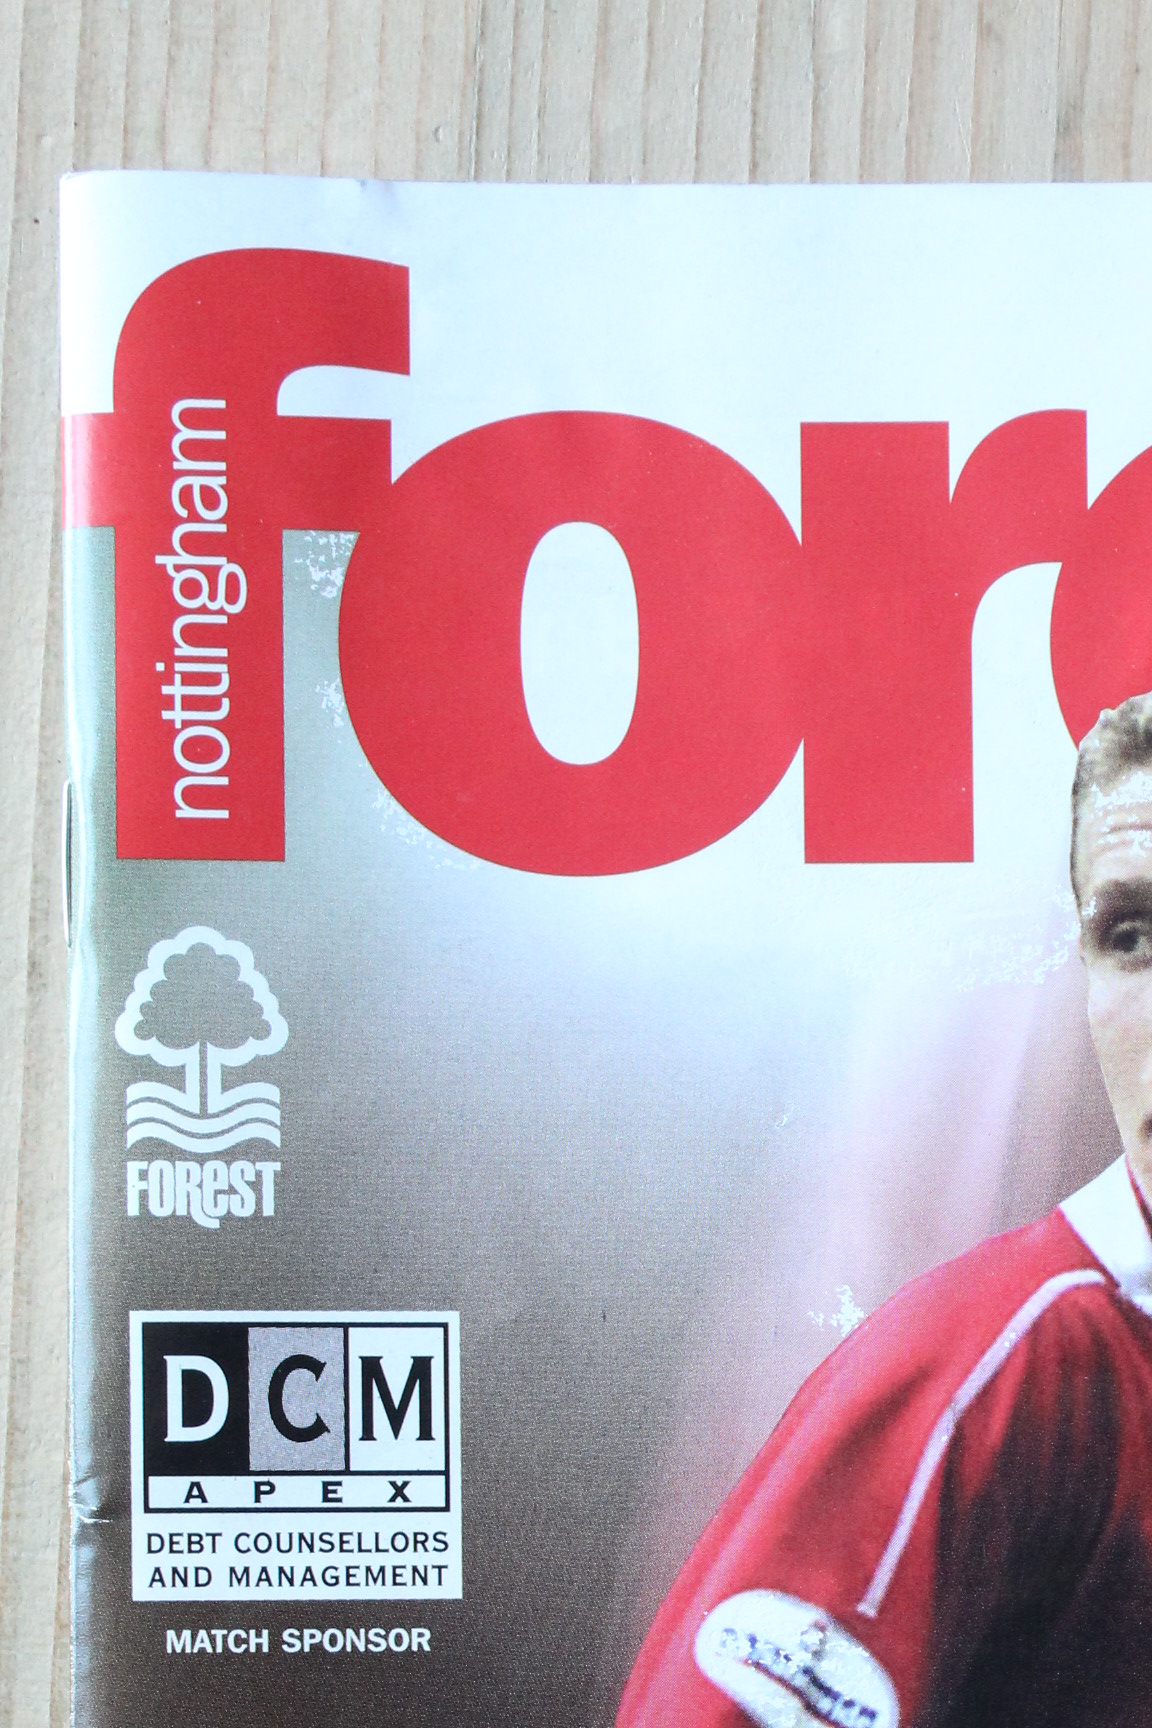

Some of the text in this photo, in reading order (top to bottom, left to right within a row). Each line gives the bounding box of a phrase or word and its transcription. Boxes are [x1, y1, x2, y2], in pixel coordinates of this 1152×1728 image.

[155, 397, 247, 822] nottingham
[126, 1160, 281, 1230] FOREST
[162, 1354, 436, 1443] DCM
[183, 1480, 413, 1504] APEX
[146, 1531, 450, 1555] DEBT COUNSELLORS
[147, 1564, 450, 1588] AND MANAGEMENT
[164, 1628, 432, 1655] MATCH SPONSOR
